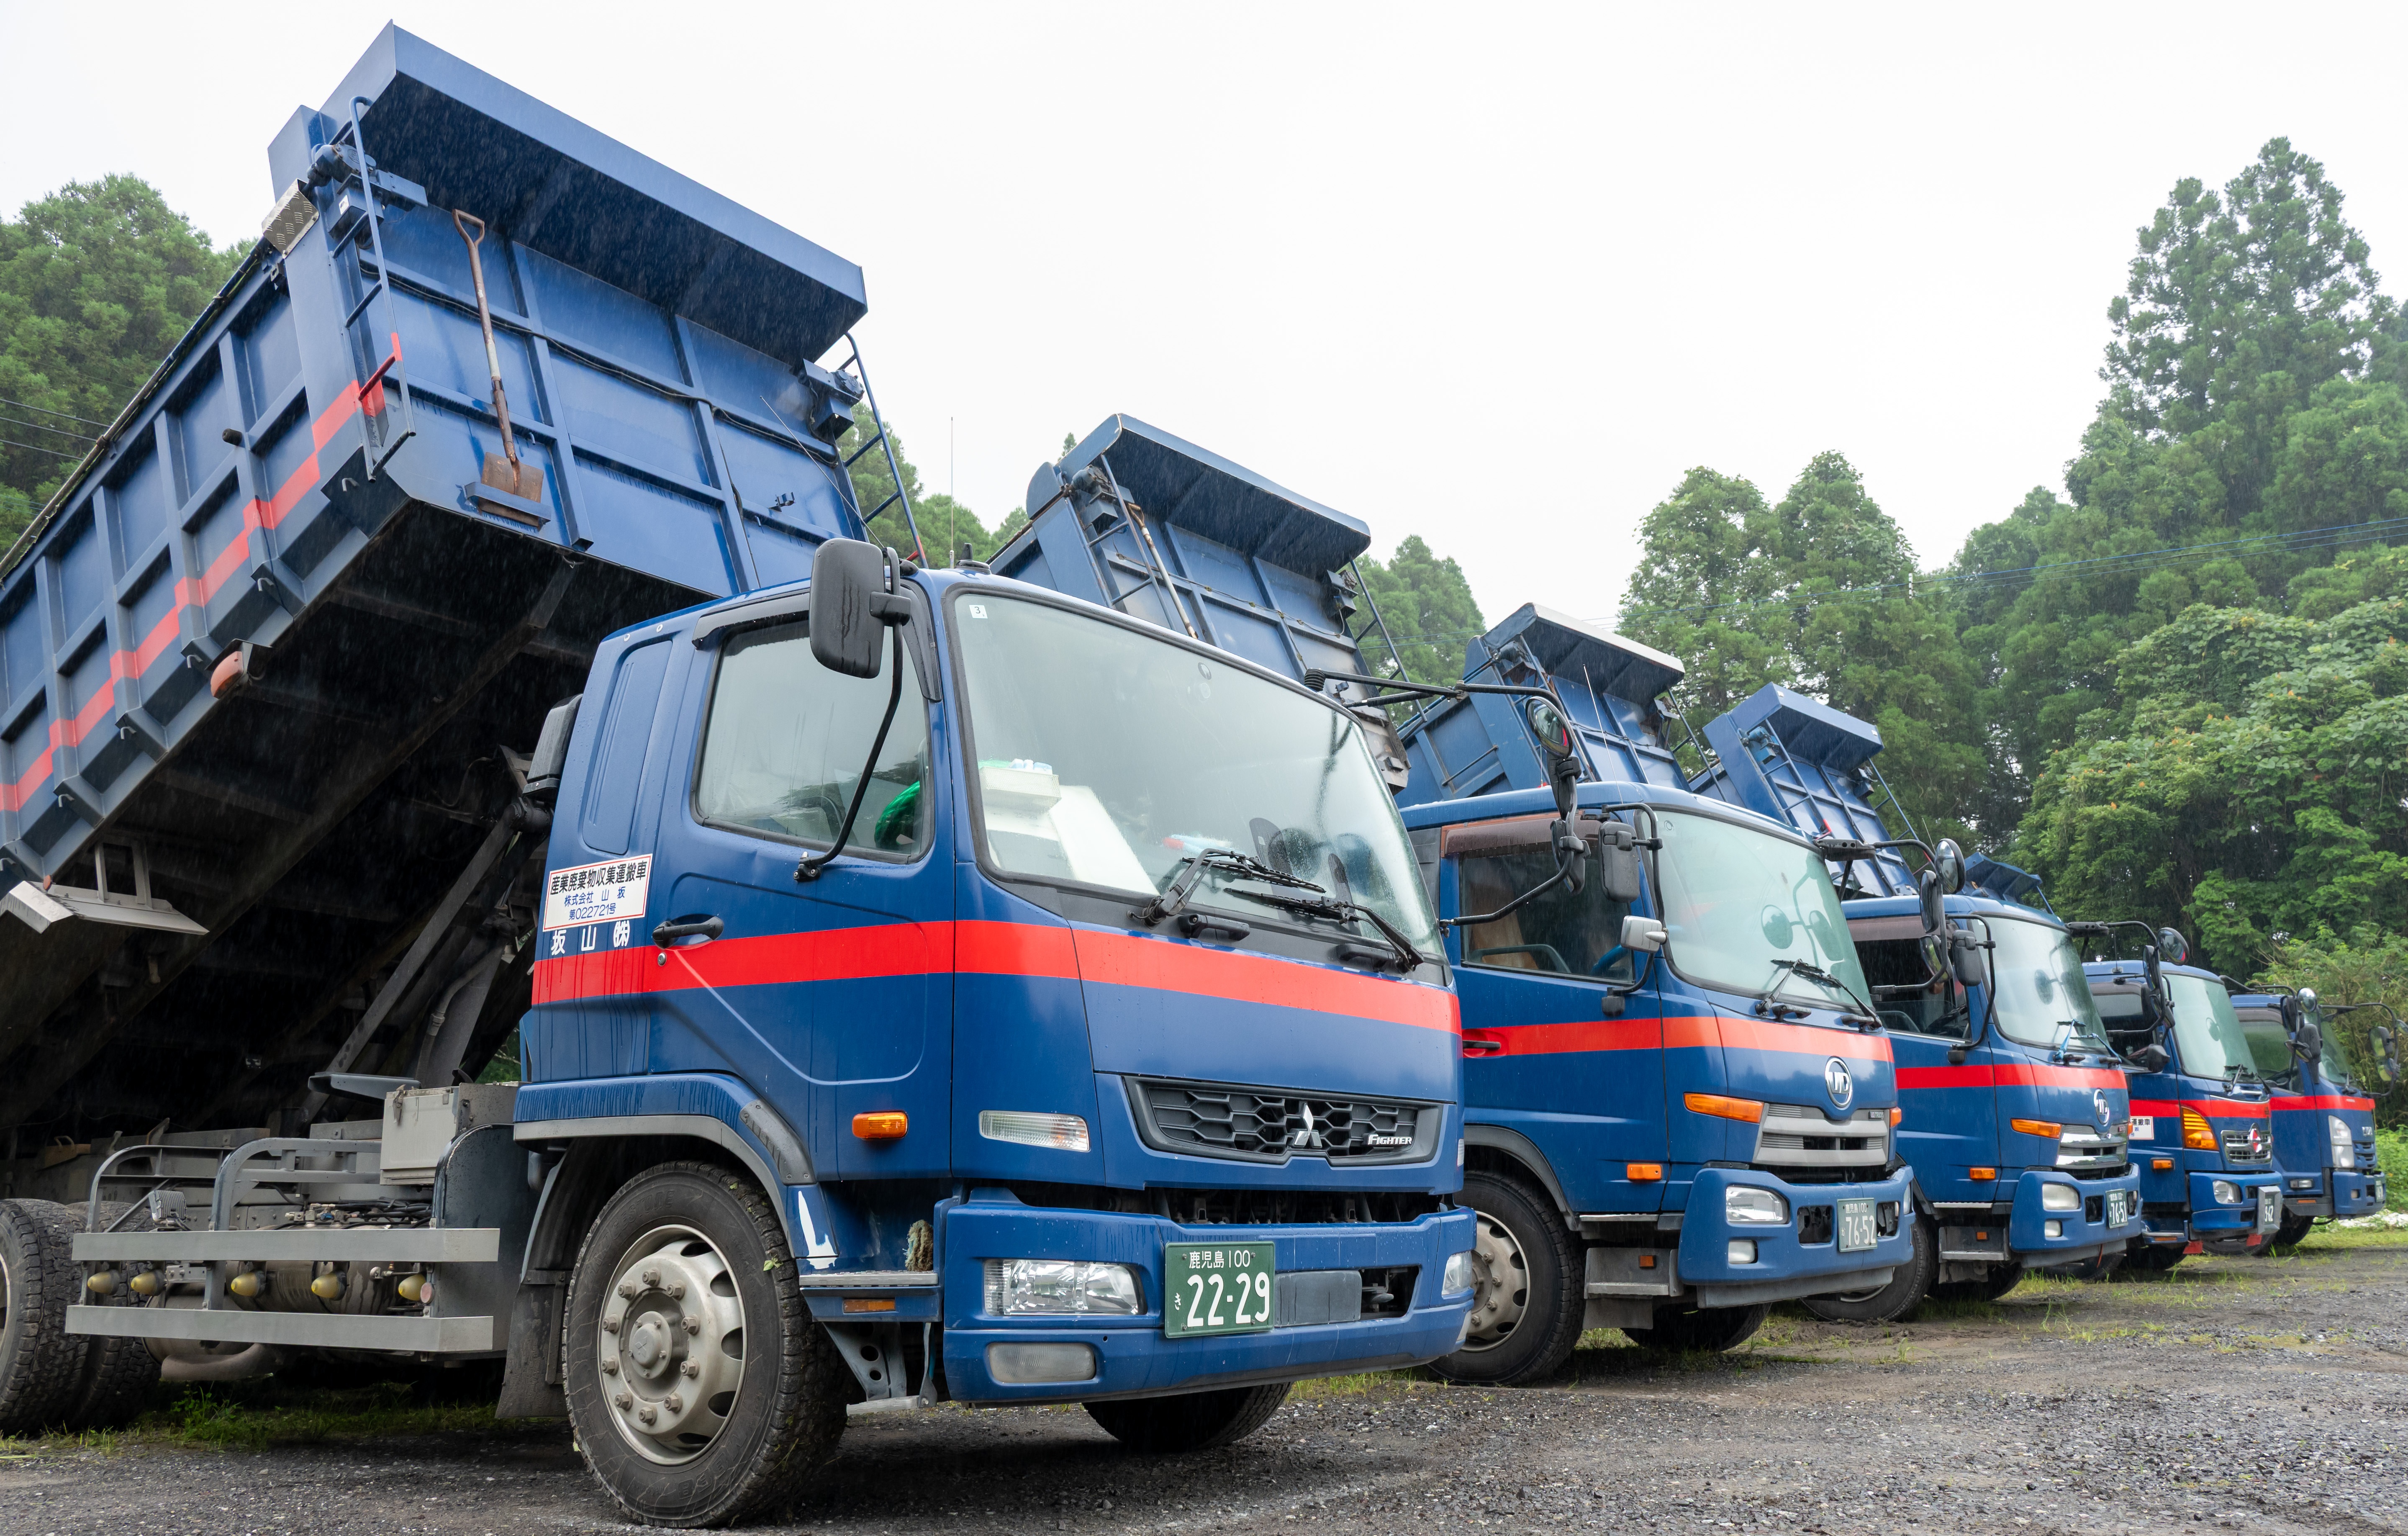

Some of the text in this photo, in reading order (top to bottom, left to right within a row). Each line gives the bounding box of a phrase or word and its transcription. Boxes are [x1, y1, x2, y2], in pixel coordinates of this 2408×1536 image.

[550, 860, 647, 895] 産業廃棄物収集運搬車
[564, 891, 593, 908] 株式会社
[569, 904, 616, 921] 第022721号
[1845, 1202, 1867, 1214] 鹿児島 100
[1189, 1250, 1250, 1269] 鹿児島 100
[1174, 1272, 1270, 1327] き 22-29
